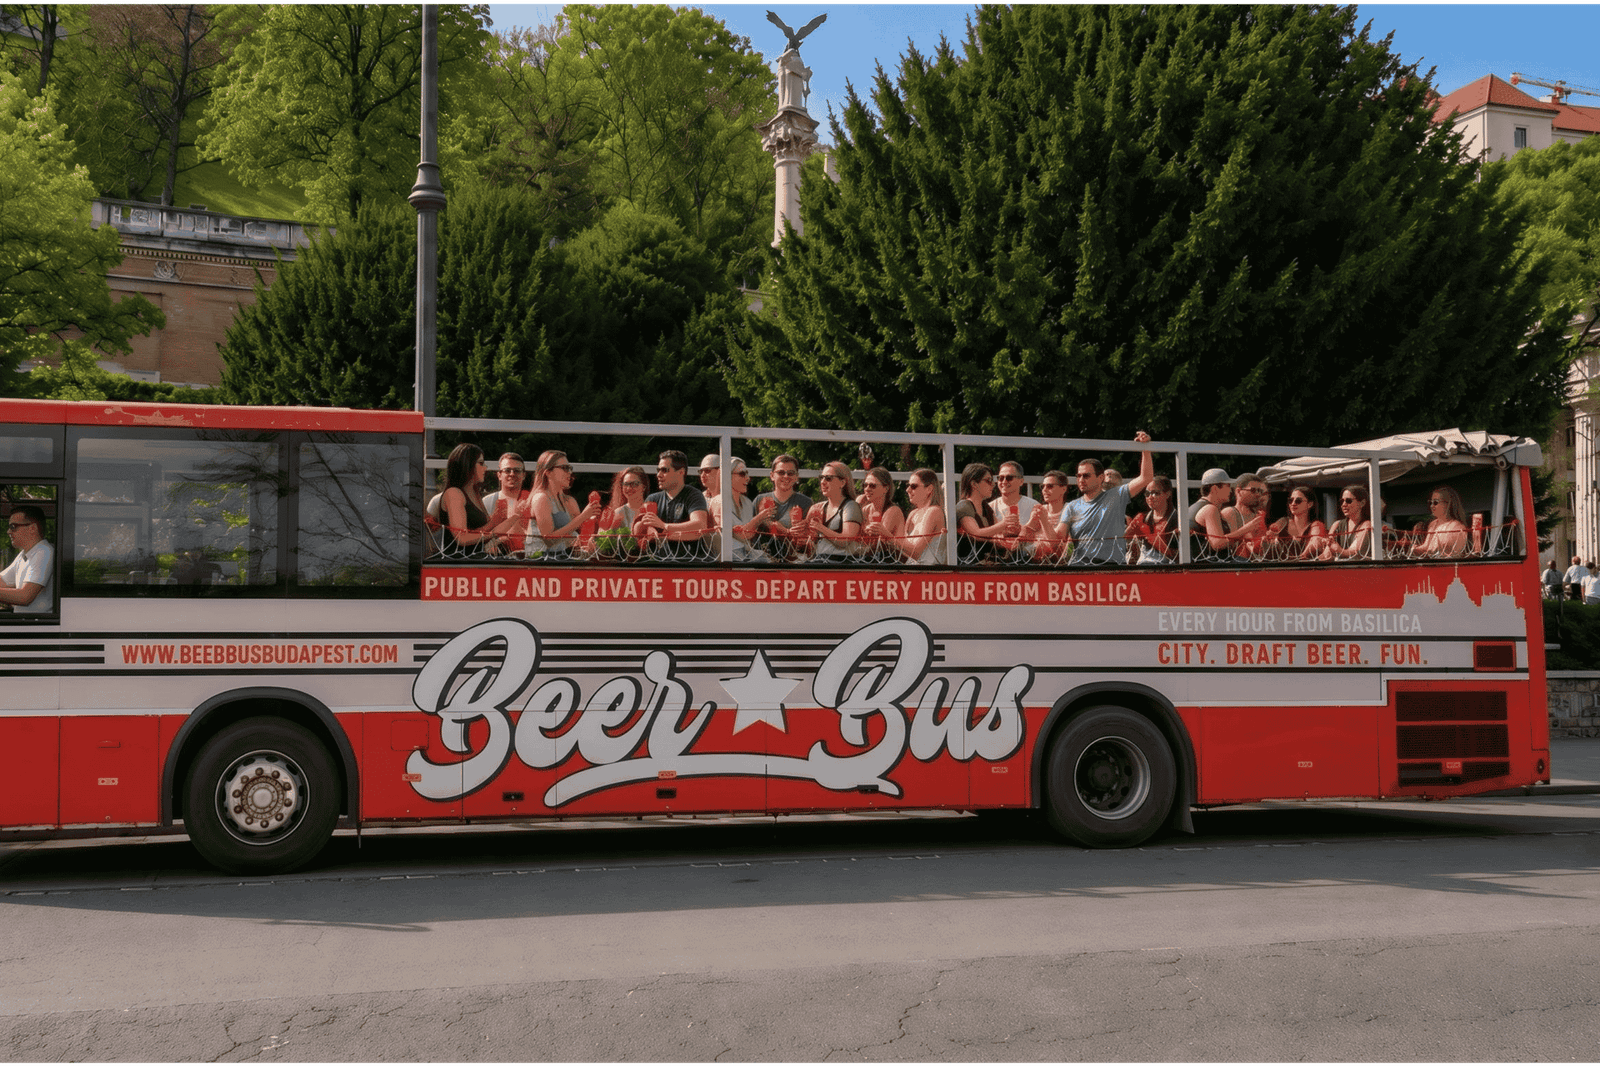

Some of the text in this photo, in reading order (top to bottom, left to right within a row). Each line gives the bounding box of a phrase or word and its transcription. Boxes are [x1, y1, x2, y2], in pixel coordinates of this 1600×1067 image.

[425, 576, 1142, 603] PUBLIC AND PRIVATE TOURS DEPART EVERY HOUR FROM BASILICA
[1158, 612, 1422, 634] EVERY HOUR FROM BASILICA
[121, 644, 398, 664] WWW.BEEBBUSBUDAPEST.COM
[1158, 642, 1428, 665] CITY. DRAFT BEER. FUN.
[406, 616, 1035, 801] Beer Bus
